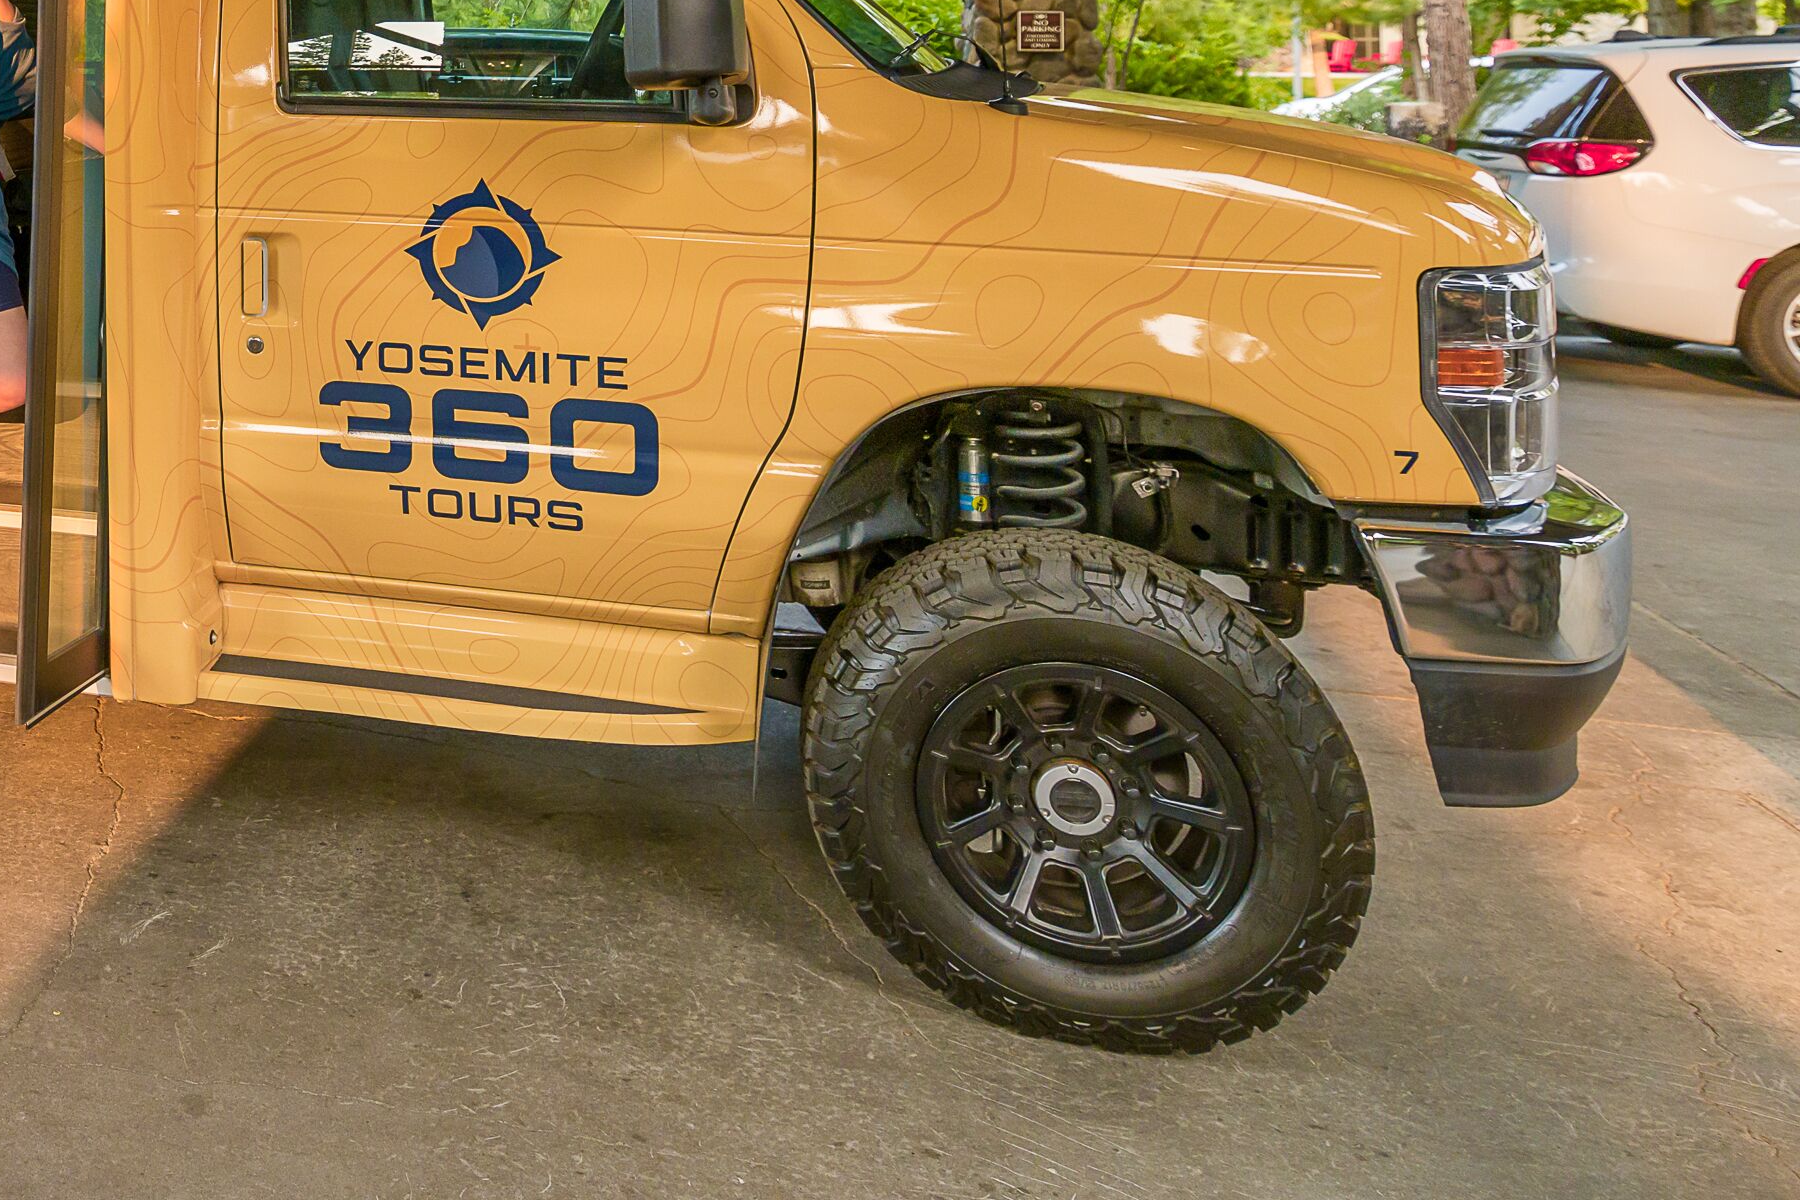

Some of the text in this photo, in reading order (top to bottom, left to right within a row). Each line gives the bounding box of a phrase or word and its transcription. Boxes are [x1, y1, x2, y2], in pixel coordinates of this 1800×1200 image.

[344, 339, 628, 391] YOSEMITE
[318, 380, 660, 497] 360
[1393, 450, 1420, 475] 7
[388, 484, 584, 532] TOURS
